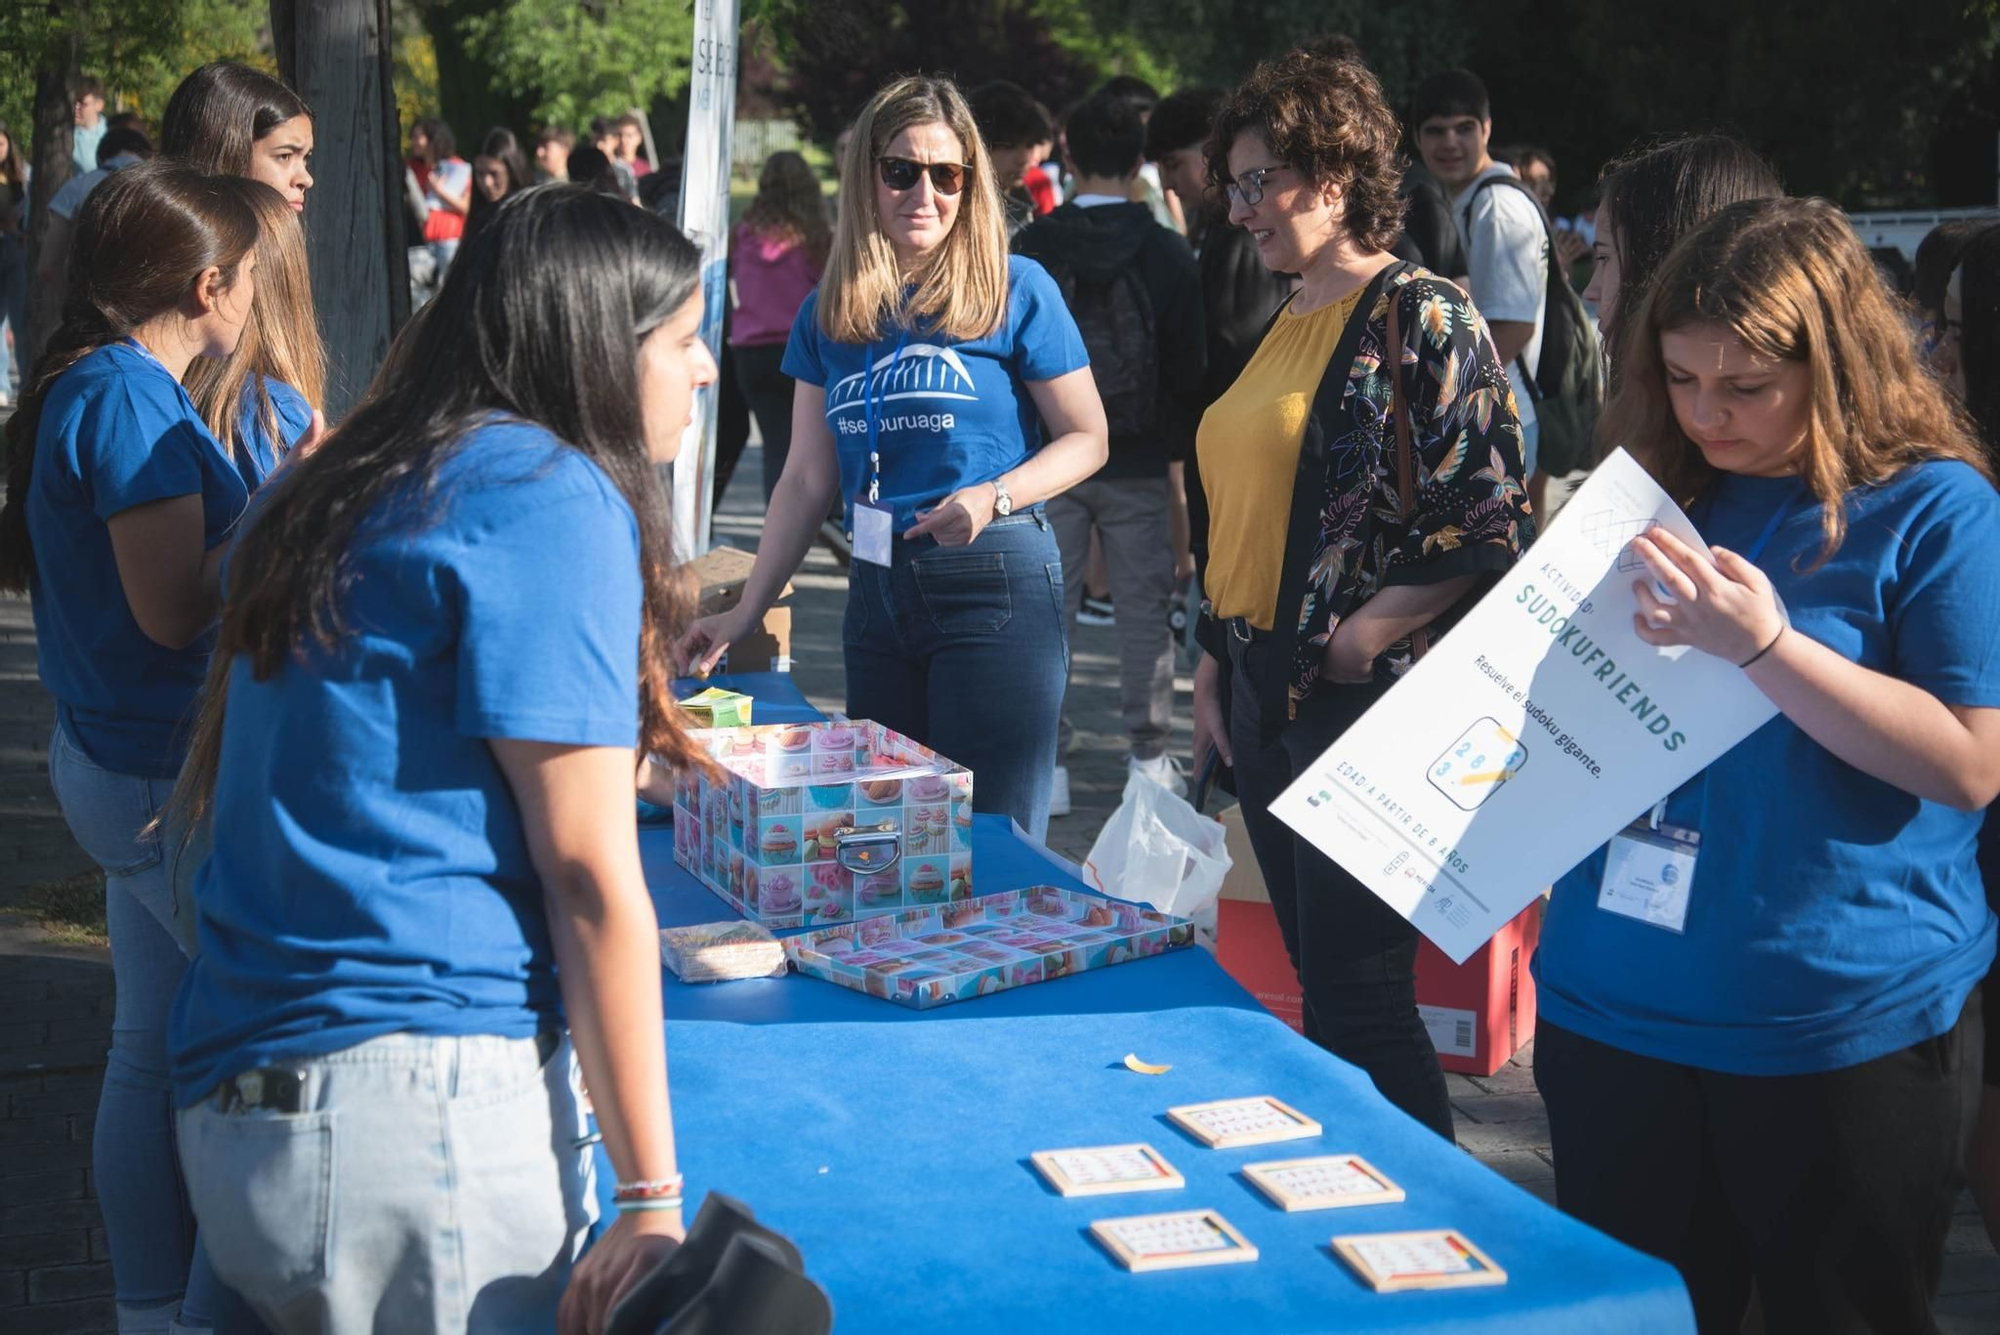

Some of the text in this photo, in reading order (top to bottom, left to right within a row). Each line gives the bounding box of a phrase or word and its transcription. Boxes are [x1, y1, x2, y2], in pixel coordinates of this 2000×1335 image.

[1540, 562, 1595, 615] ACTIVIDAD:
[1516, 584, 1687, 752] SUDOKUFRIENDS
[1455, 741, 1472, 758] 2
[1474, 654, 1602, 779] Resuelve el sudoku gigante.
[1436, 761, 1452, 777] 3
[1367, 786, 1376, 796] A
[1376, 793, 1413, 826] PARTIR
[1411, 823, 1429, 838] DE
[1438, 846, 1469, 874] AÑOS
